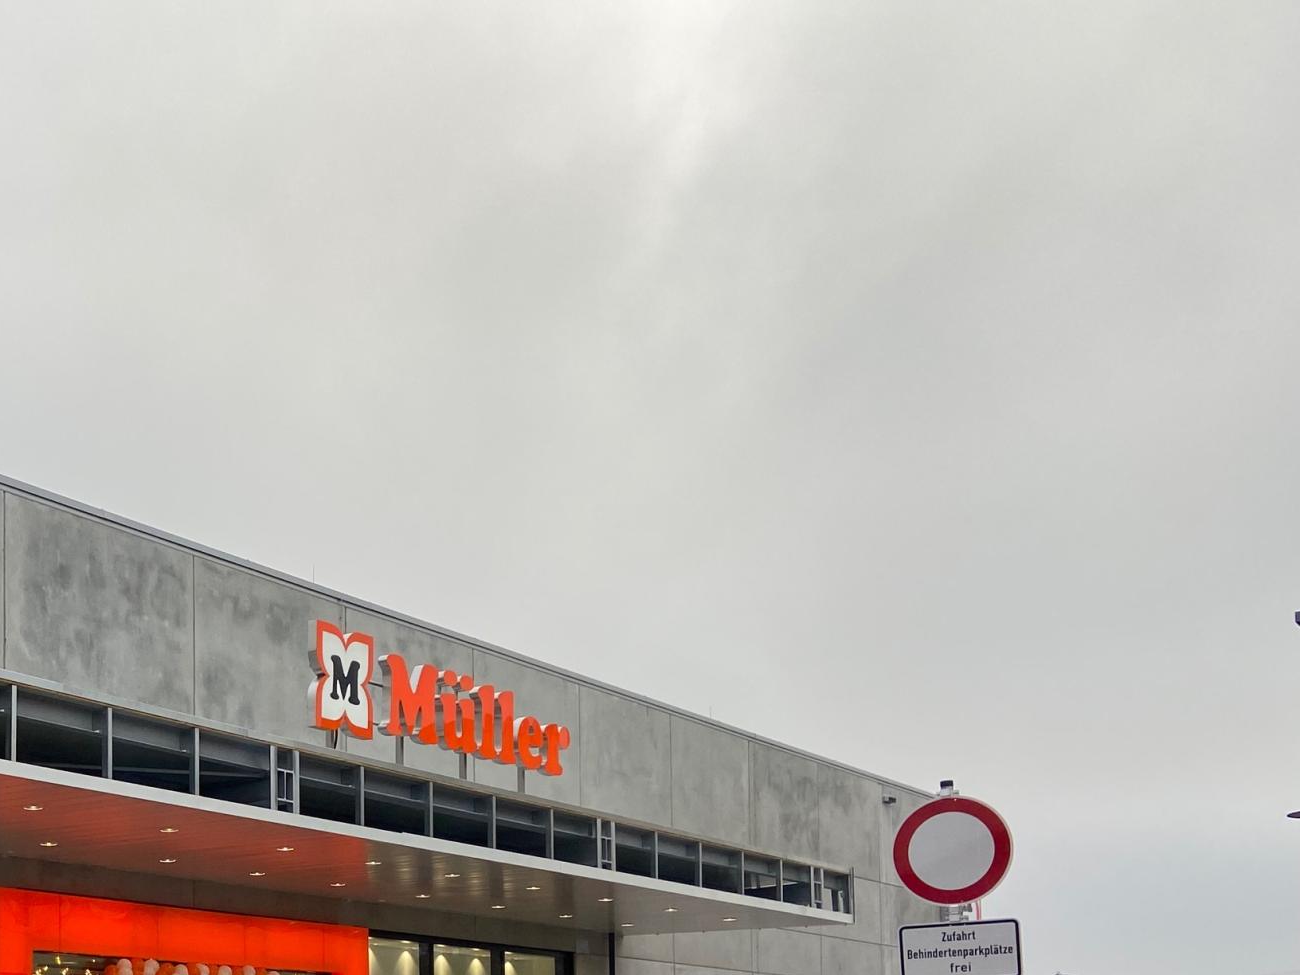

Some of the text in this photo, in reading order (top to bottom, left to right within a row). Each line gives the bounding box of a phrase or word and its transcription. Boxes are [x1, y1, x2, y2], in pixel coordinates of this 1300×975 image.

[330, 653, 571, 777] M Müller
[941, 931, 976, 942] Zufahrt
[907, 944, 1013, 960] Behindertenparkplätze
[950, 962, 972, 973] frei
